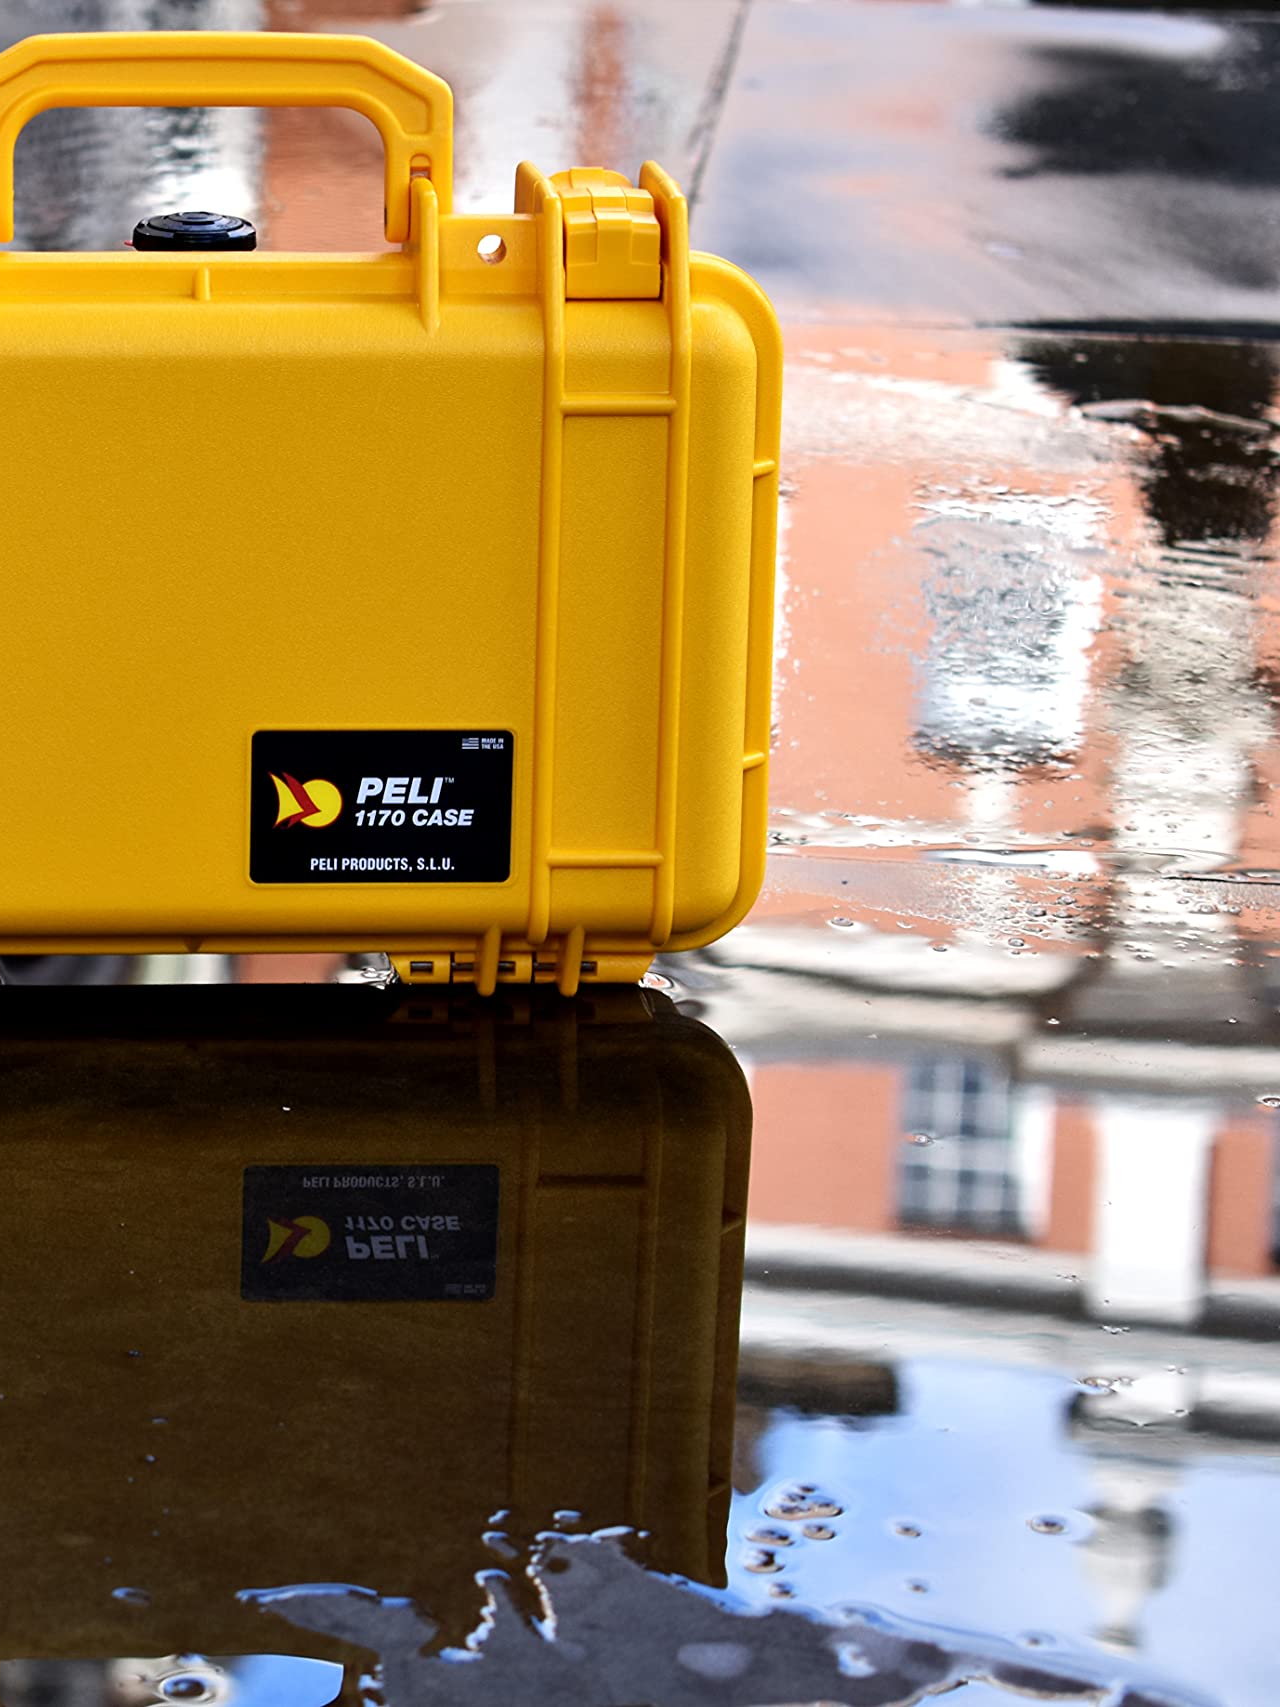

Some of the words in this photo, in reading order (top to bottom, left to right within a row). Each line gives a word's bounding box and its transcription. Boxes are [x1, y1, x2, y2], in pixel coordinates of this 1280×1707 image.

[354, 809, 406, 827] 1170
[411, 808, 475, 827] CASE
[310, 857, 338, 871] PELI
[341, 857, 413, 872] PRODUCTS,
[416, 857, 455, 871] S.L.U.
